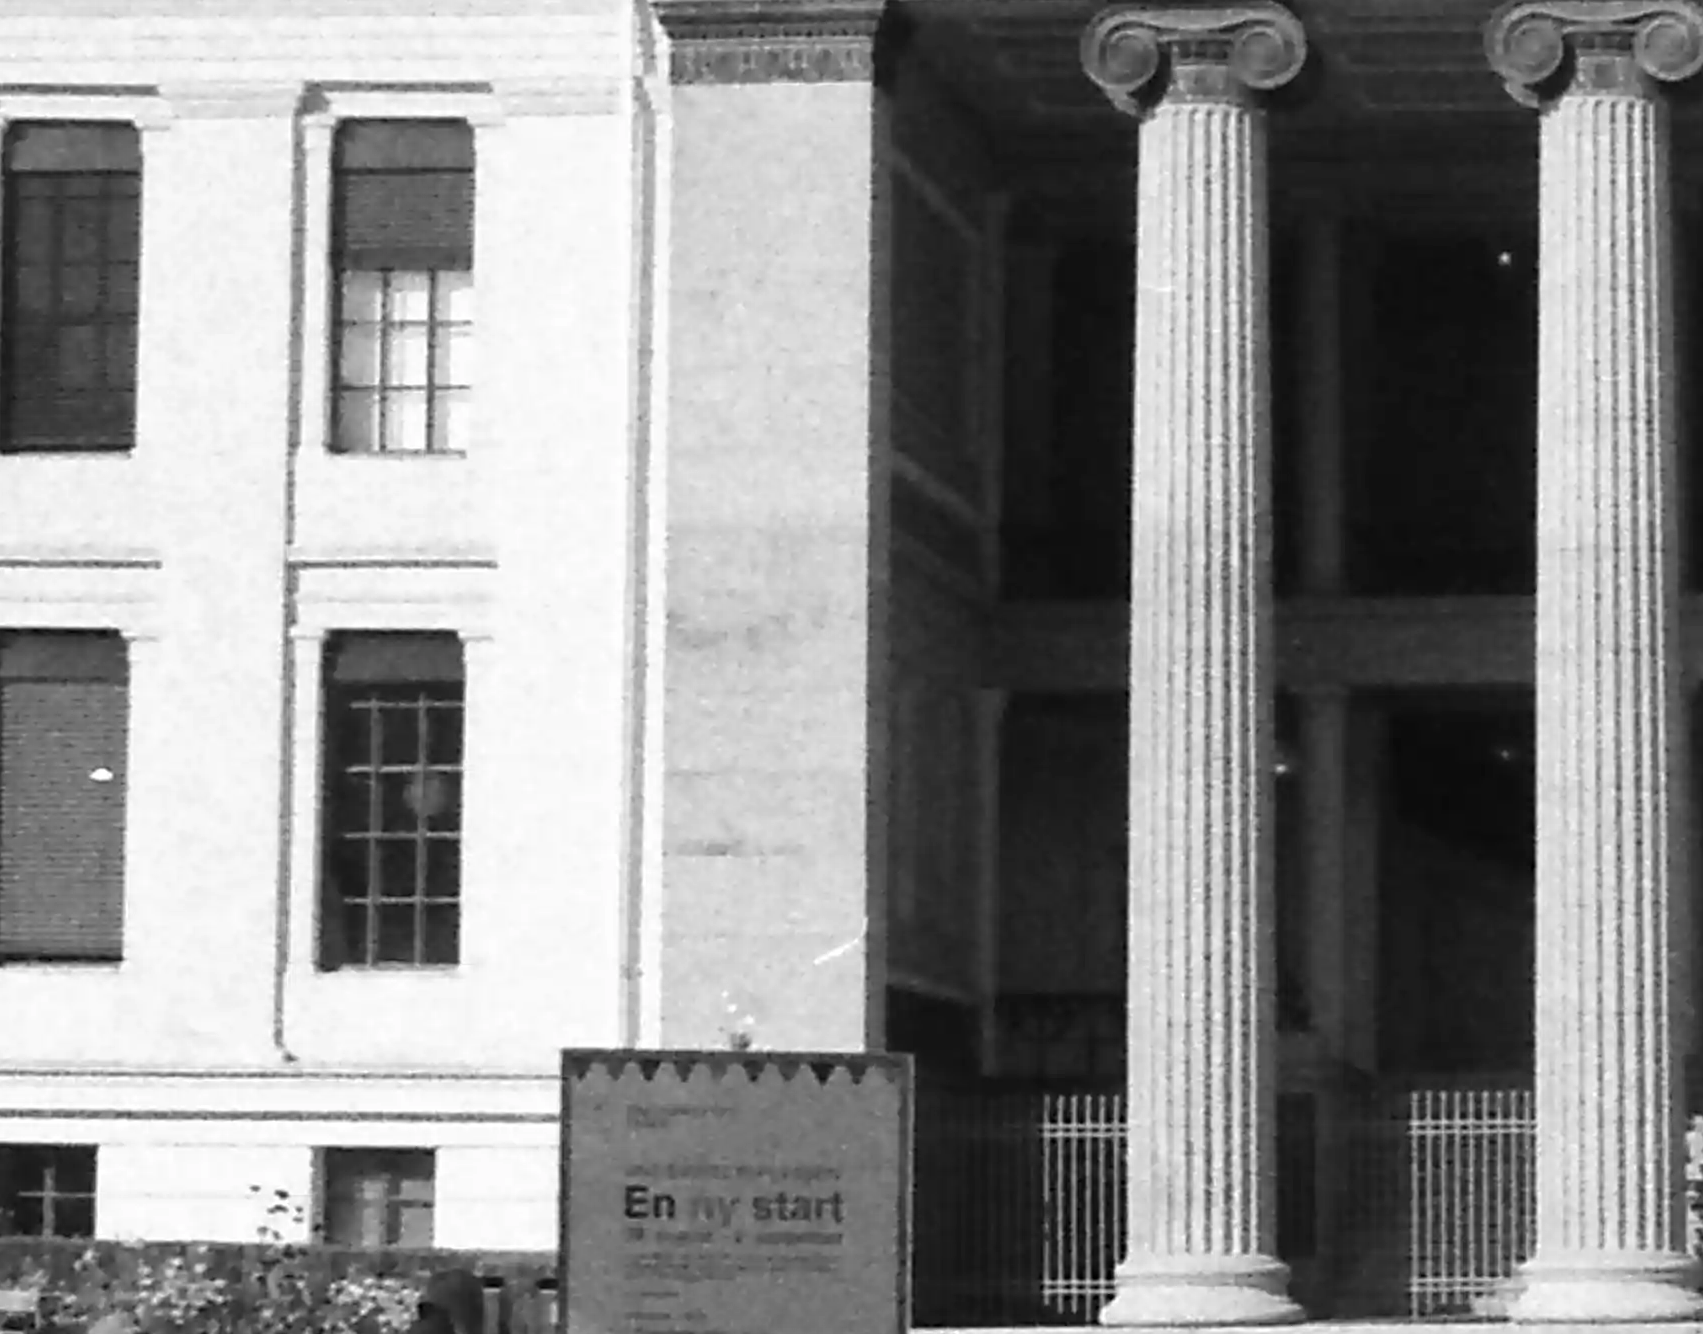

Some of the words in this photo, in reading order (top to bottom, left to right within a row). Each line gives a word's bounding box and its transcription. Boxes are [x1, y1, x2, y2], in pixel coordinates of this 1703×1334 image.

[623, 1184, 677, 1220] En
[690, 1195, 741, 1228] ny
[751, 1191, 845, 1224] start
